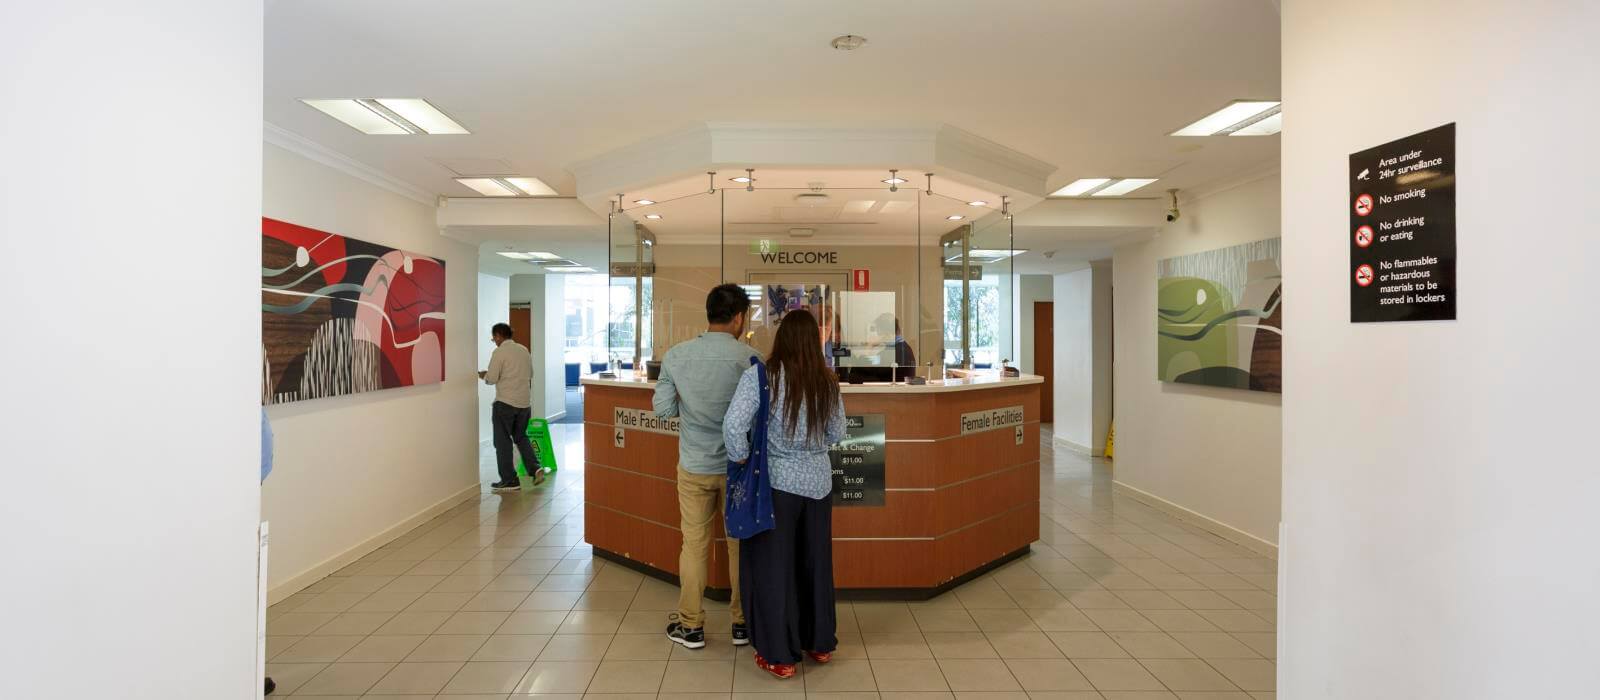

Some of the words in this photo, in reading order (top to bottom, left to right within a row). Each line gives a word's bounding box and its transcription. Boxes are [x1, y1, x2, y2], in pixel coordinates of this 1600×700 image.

[1379, 157, 1397, 168] Area
[1400, 150, 1422, 162] under
[1379, 169, 1396, 179] 24hr
[1398, 157, 1443, 175] surveillance
[1379, 195, 1392, 204] No
[1393, 188, 1426, 202] smoking
[1380, 221, 1392, 230] No
[1394, 216, 1425, 228] drinking
[1391, 230, 1413, 240] eating
[760, 251, 838, 264] WELCOME
[1380, 261, 1392, 269] No
[1394, 256, 1438, 268] flammables
[1390, 270, 1430, 280] hazardous
[1380, 282, 1413, 293] materials
[1427, 280, 1438, 290] be
[1380, 294, 1405, 305] stored
[1406, 294, 1414, 303] in
[1415, 293, 1446, 303] lockers
[615, 410, 637, 426] Male
[962, 414, 991, 432] Female
[992, 409, 1023, 427] Facilities
[850, 443, 875, 453] Change
[842, 456, 863, 464] $11.00
[844, 477, 864, 485] $11.00
[842, 491, 863, 499] $11.00
